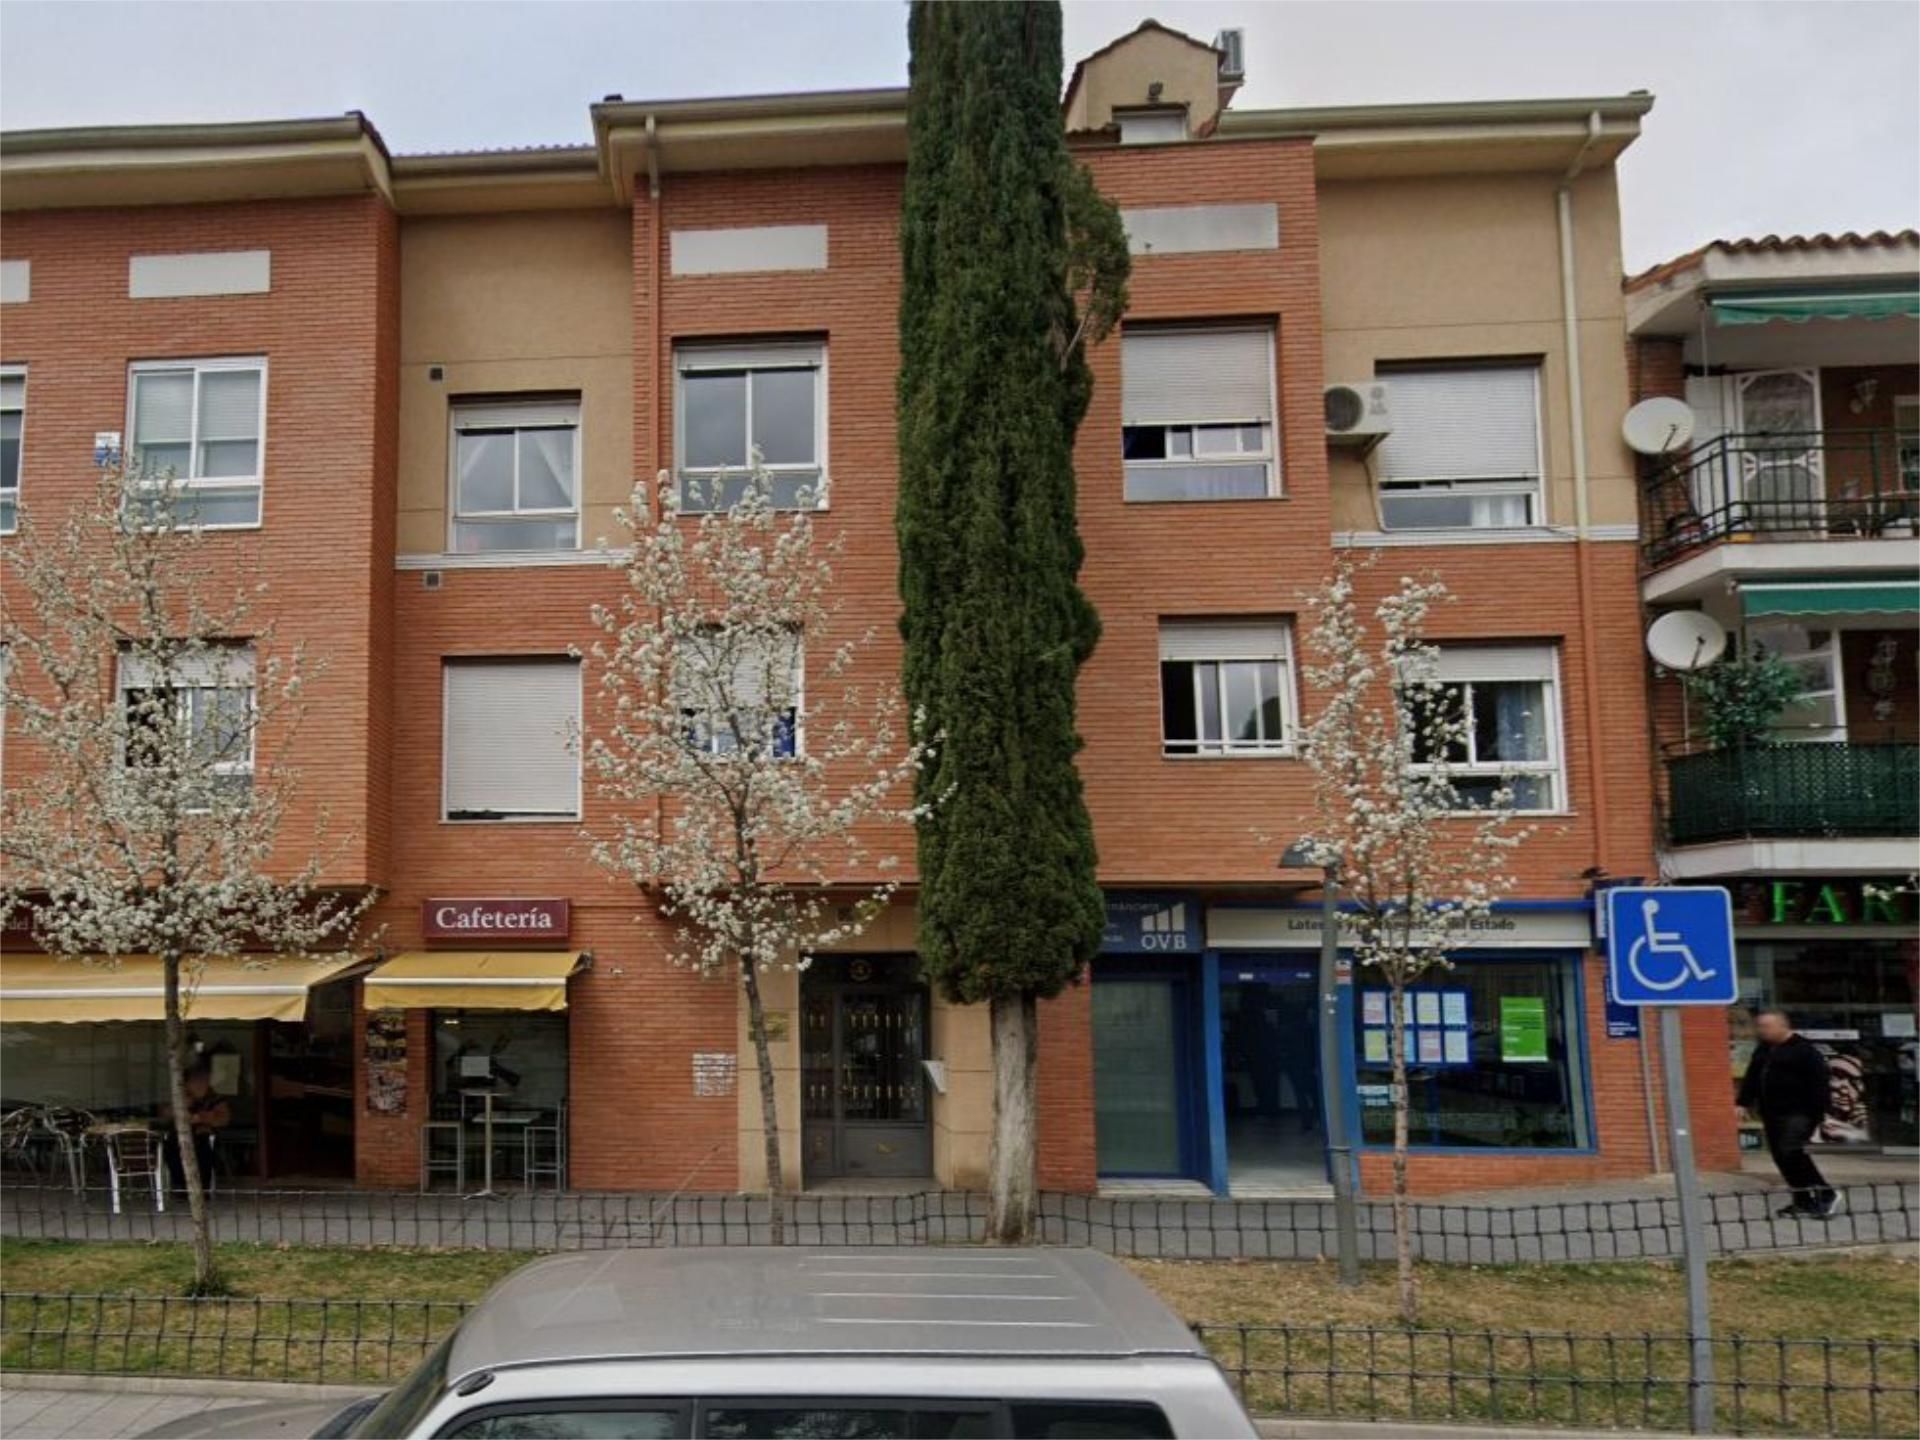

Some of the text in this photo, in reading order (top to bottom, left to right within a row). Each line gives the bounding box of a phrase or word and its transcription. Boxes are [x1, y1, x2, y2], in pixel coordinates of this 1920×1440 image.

[436, 907, 552, 929] Cafetería
[1470, 917, 1515, 930] Estado
[1141, 934, 1187, 950] OVB
